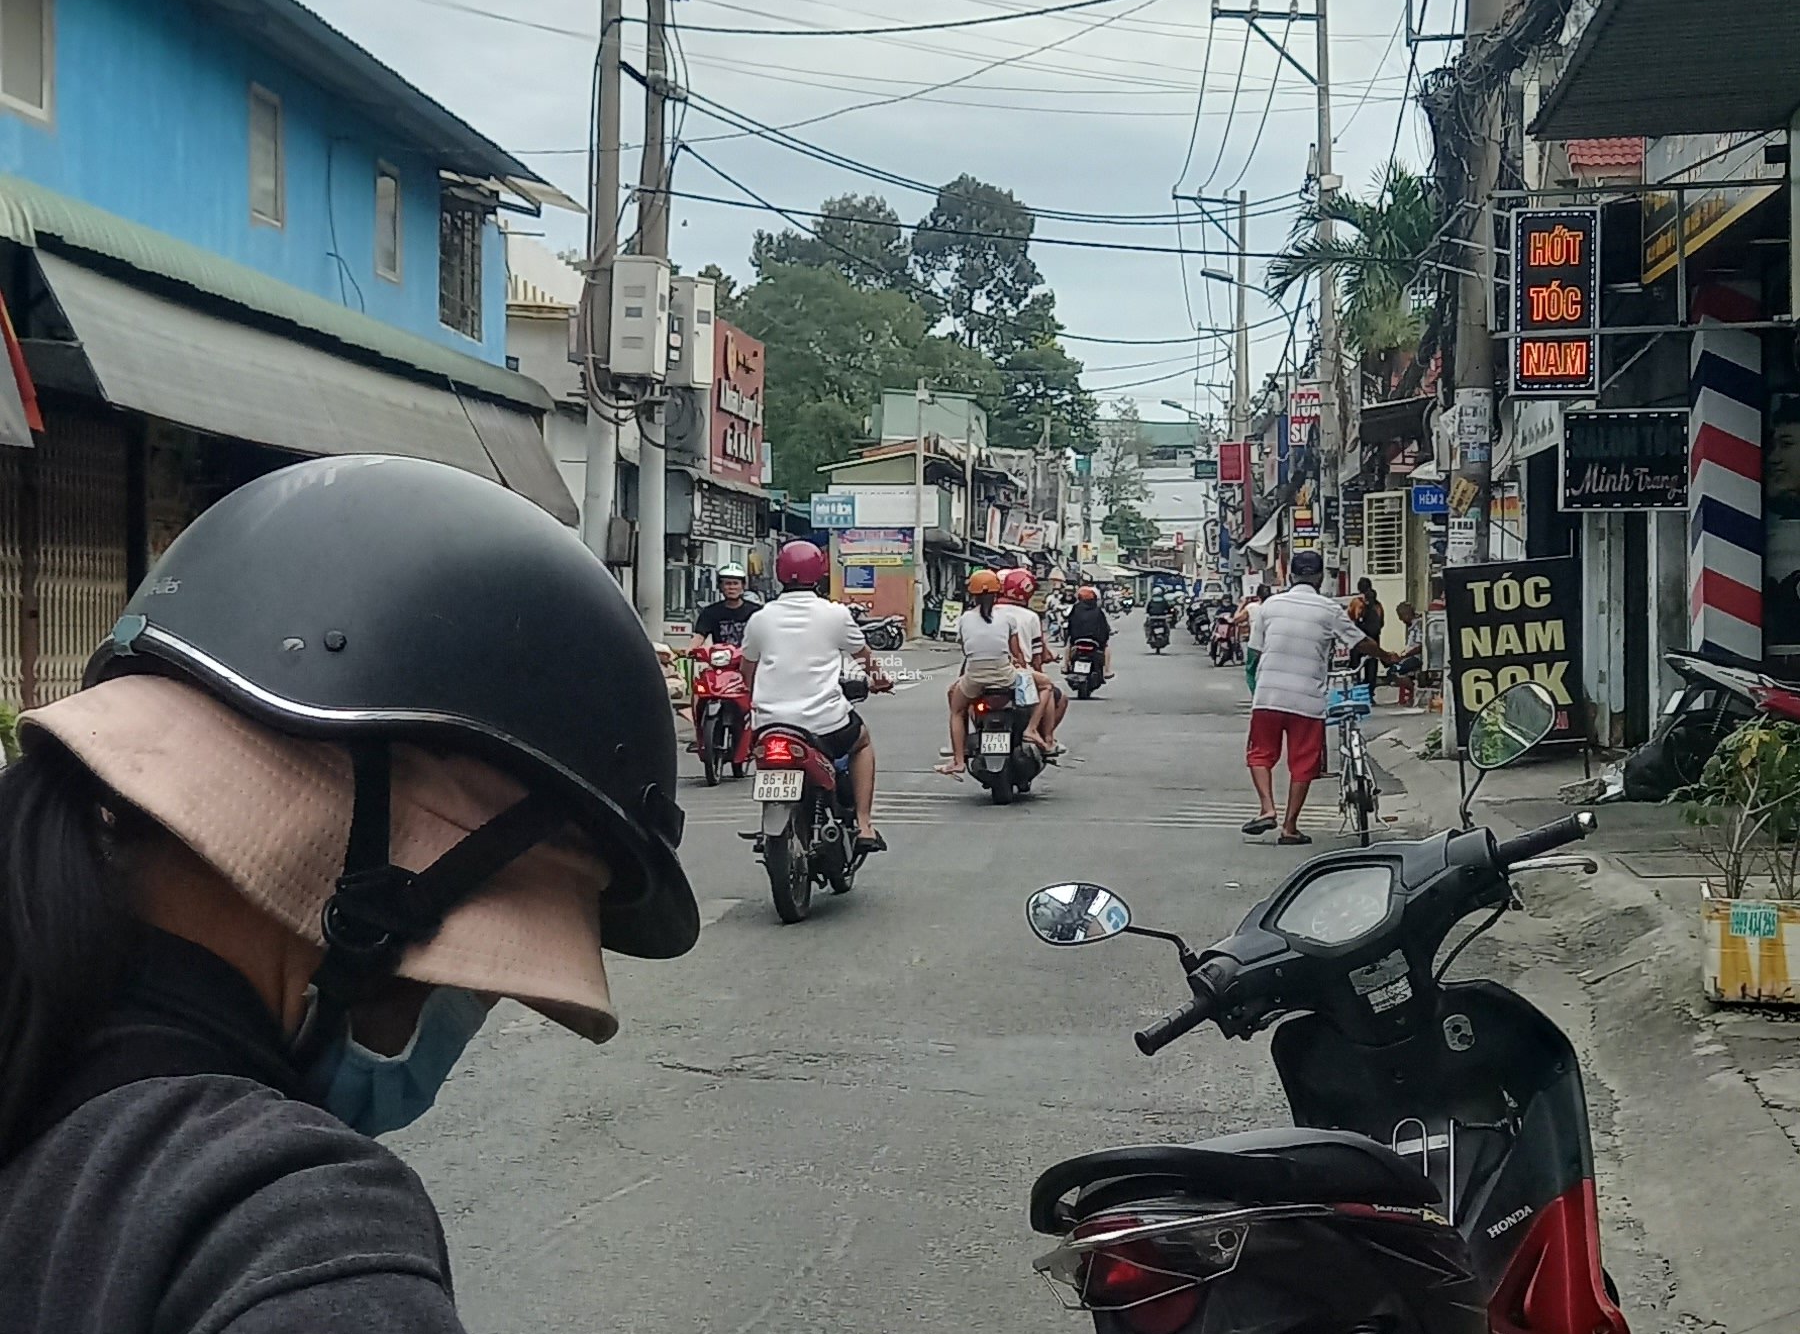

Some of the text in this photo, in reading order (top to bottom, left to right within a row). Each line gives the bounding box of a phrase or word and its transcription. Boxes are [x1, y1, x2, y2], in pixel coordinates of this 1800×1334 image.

[1530, 225, 1583, 266] HỚT
[1530, 280, 1581, 321] TÓC
[1523, 342, 1587, 376] NAM
[1571, 463, 1682, 500] Minh Trang
[1466, 572, 1552, 613] TÓC
[1460, 620, 1566, 659] NAM
[1486, 1205, 1534, 1238] HONDA
